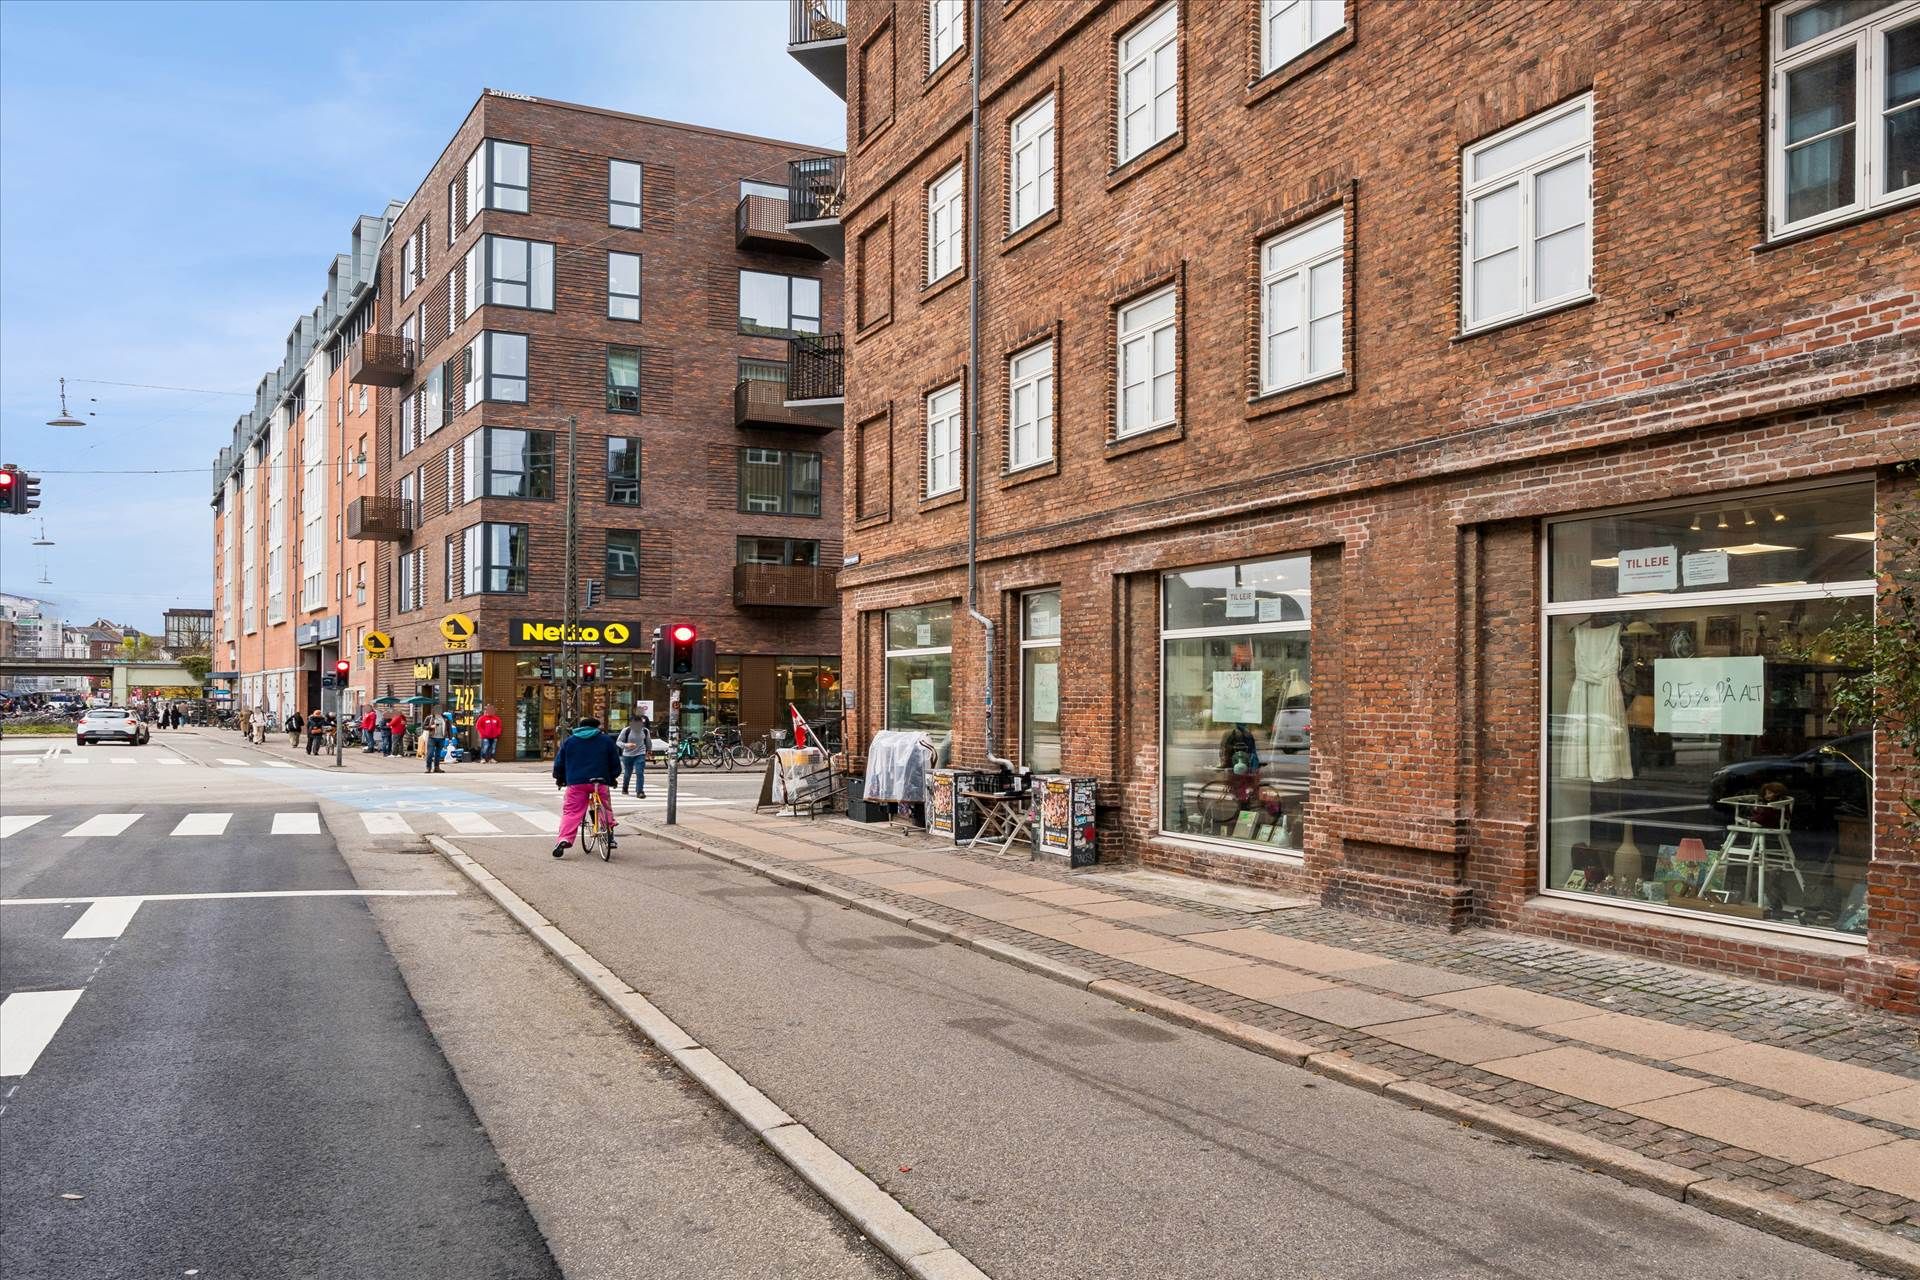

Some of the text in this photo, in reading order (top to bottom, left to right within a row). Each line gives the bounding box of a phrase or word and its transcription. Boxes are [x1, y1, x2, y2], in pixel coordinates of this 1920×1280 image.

[1626, 556, 1669, 568] TIL LEJE
[522, 623, 599, 641] Netto
[455, 688, 474, 711] 7-22
[1662, 677, 1763, 708] 25% PÅ ALT
